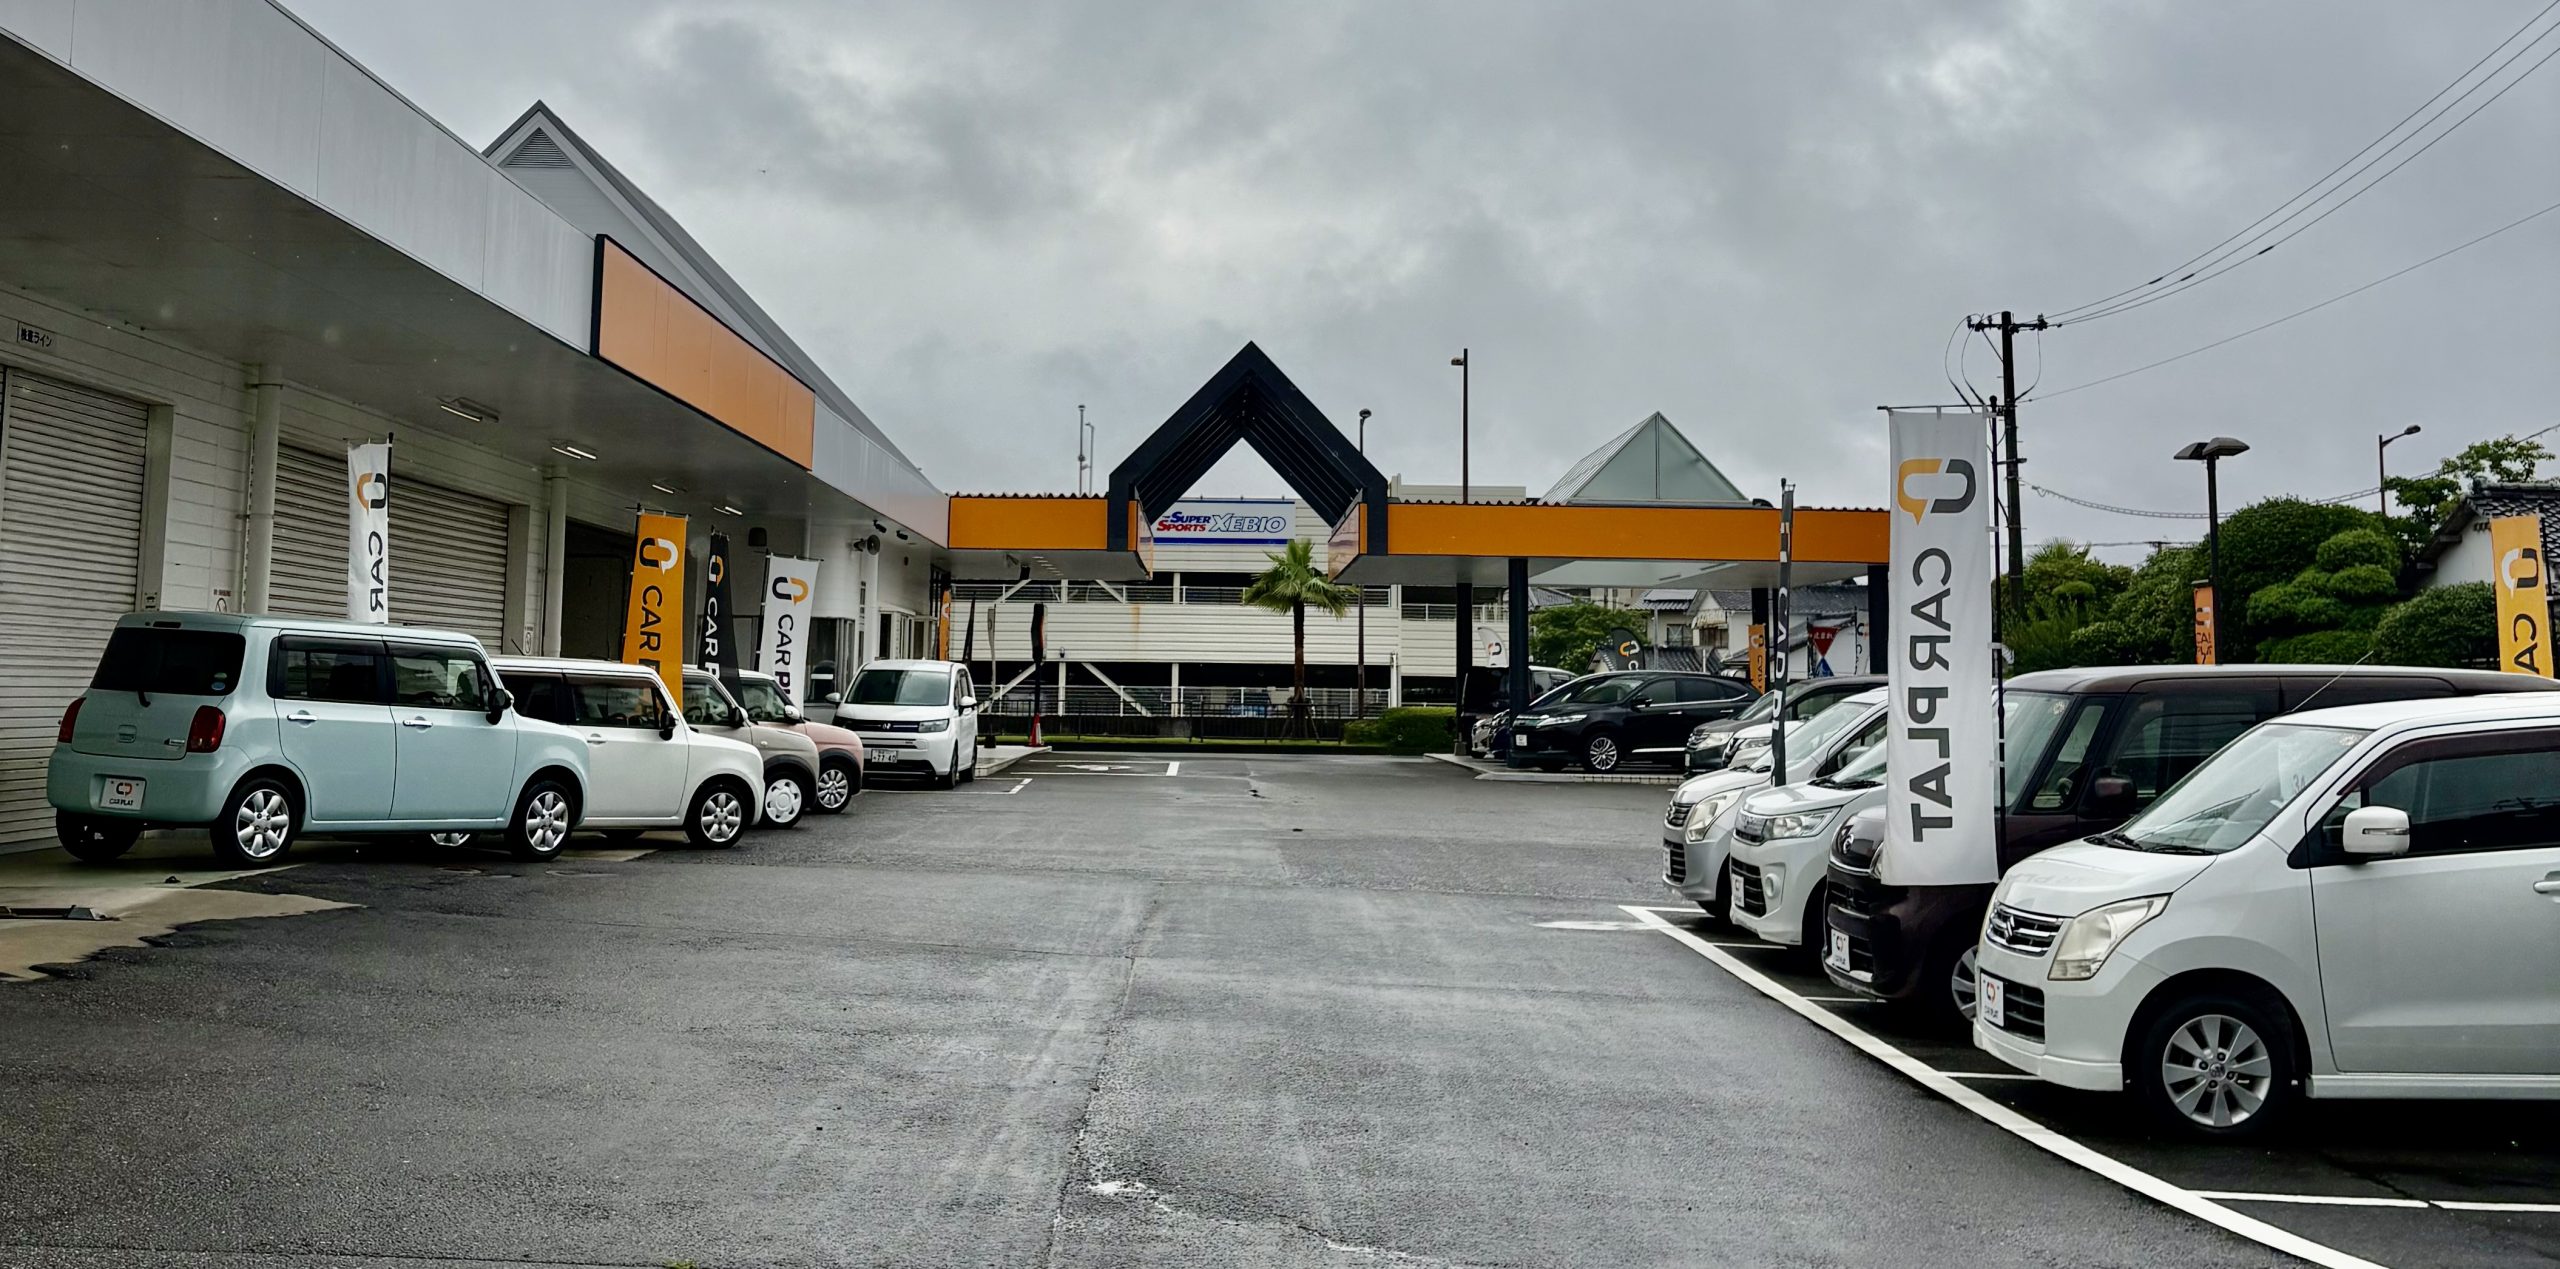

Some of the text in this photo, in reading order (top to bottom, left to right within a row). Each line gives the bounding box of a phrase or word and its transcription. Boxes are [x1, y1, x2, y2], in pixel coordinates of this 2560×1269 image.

[1156, 519, 1206, 532] SPORTS
[1170, 511, 1211, 523] SUPER
[1208, 512, 1287, 533] XEBIO
[639, 585, 663, 652] CAR
[704, 596, 720, 657] CAR
[775, 614, 794, 666] CAR
